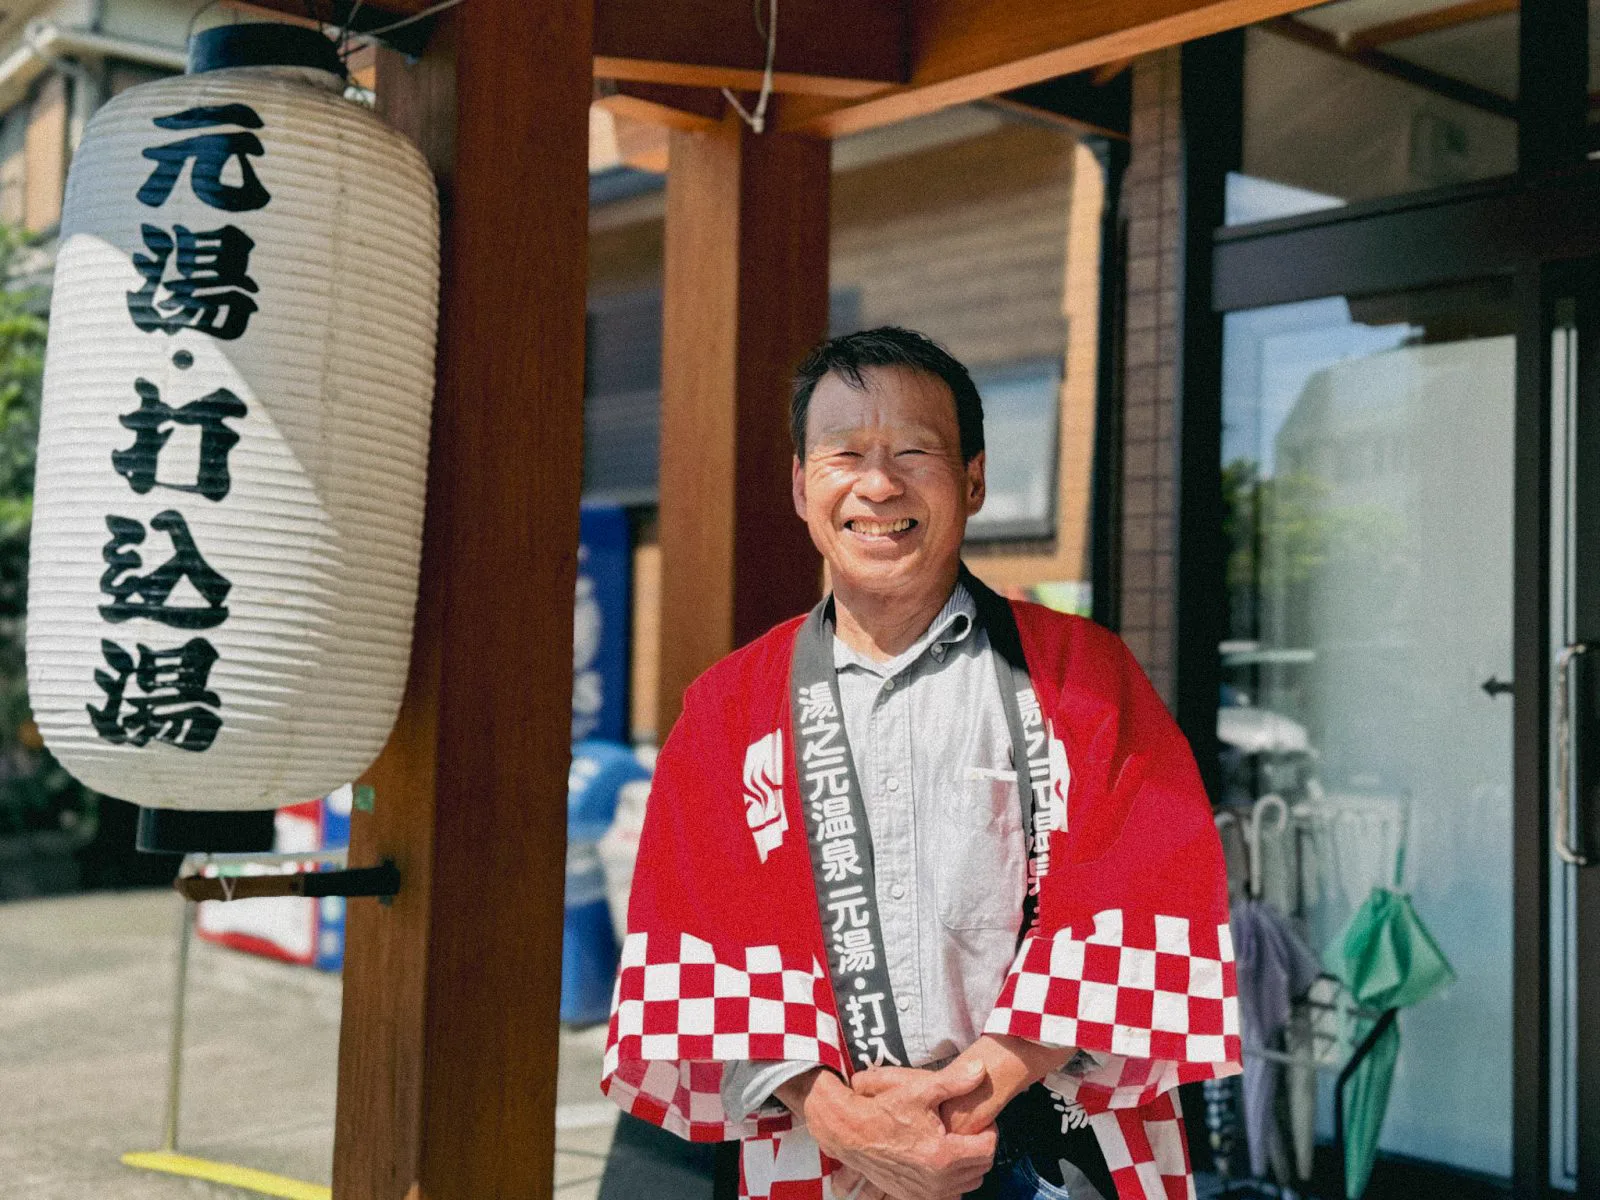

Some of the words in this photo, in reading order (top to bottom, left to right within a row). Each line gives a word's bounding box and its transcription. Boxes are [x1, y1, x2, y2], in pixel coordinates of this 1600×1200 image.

[86, 103, 271, 752] 元湯・打込湯
